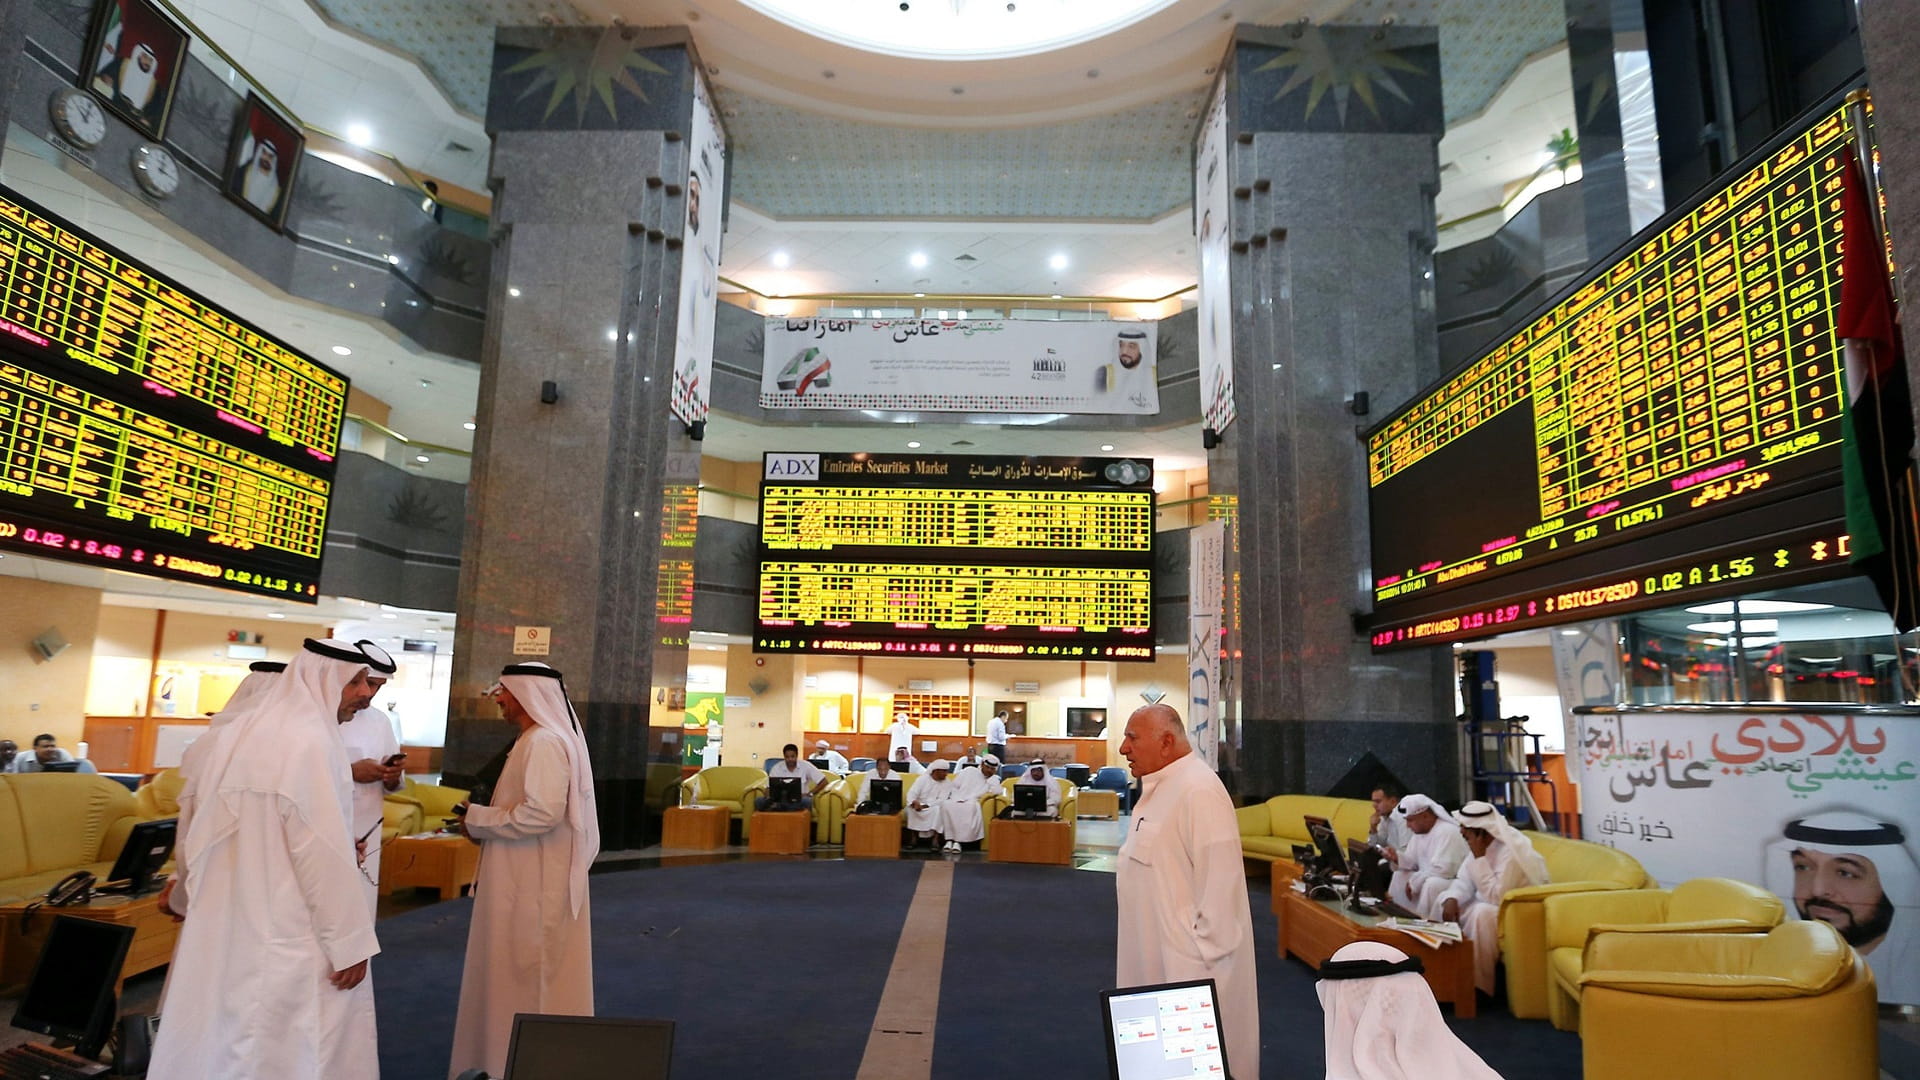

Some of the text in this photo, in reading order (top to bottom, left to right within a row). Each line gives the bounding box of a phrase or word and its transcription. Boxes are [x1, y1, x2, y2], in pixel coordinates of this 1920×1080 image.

[1825, 176, 1841, 193] 18
[770, 460, 815, 475] ADX
[823, 459, 948, 475] Emirates Securities Market
[23, 527, 65, 548] 0.02
[224, 568, 252, 584] 0.02
[1557, 580, 1639, 612] DSI(137850)
[1645, 572, 1683, 595] 0.02
[1709, 556, 1755, 582] 1.56
[1462, 612, 1485, 630] 0.15
[1495, 605, 1520, 623] 2.97
[885, 642, 906, 651] 0.11
[919, 643, 941, 652] 3.01
[1711, 715, 1886, 776] بلادي
[1786, 748, 1917, 799] عيشي
